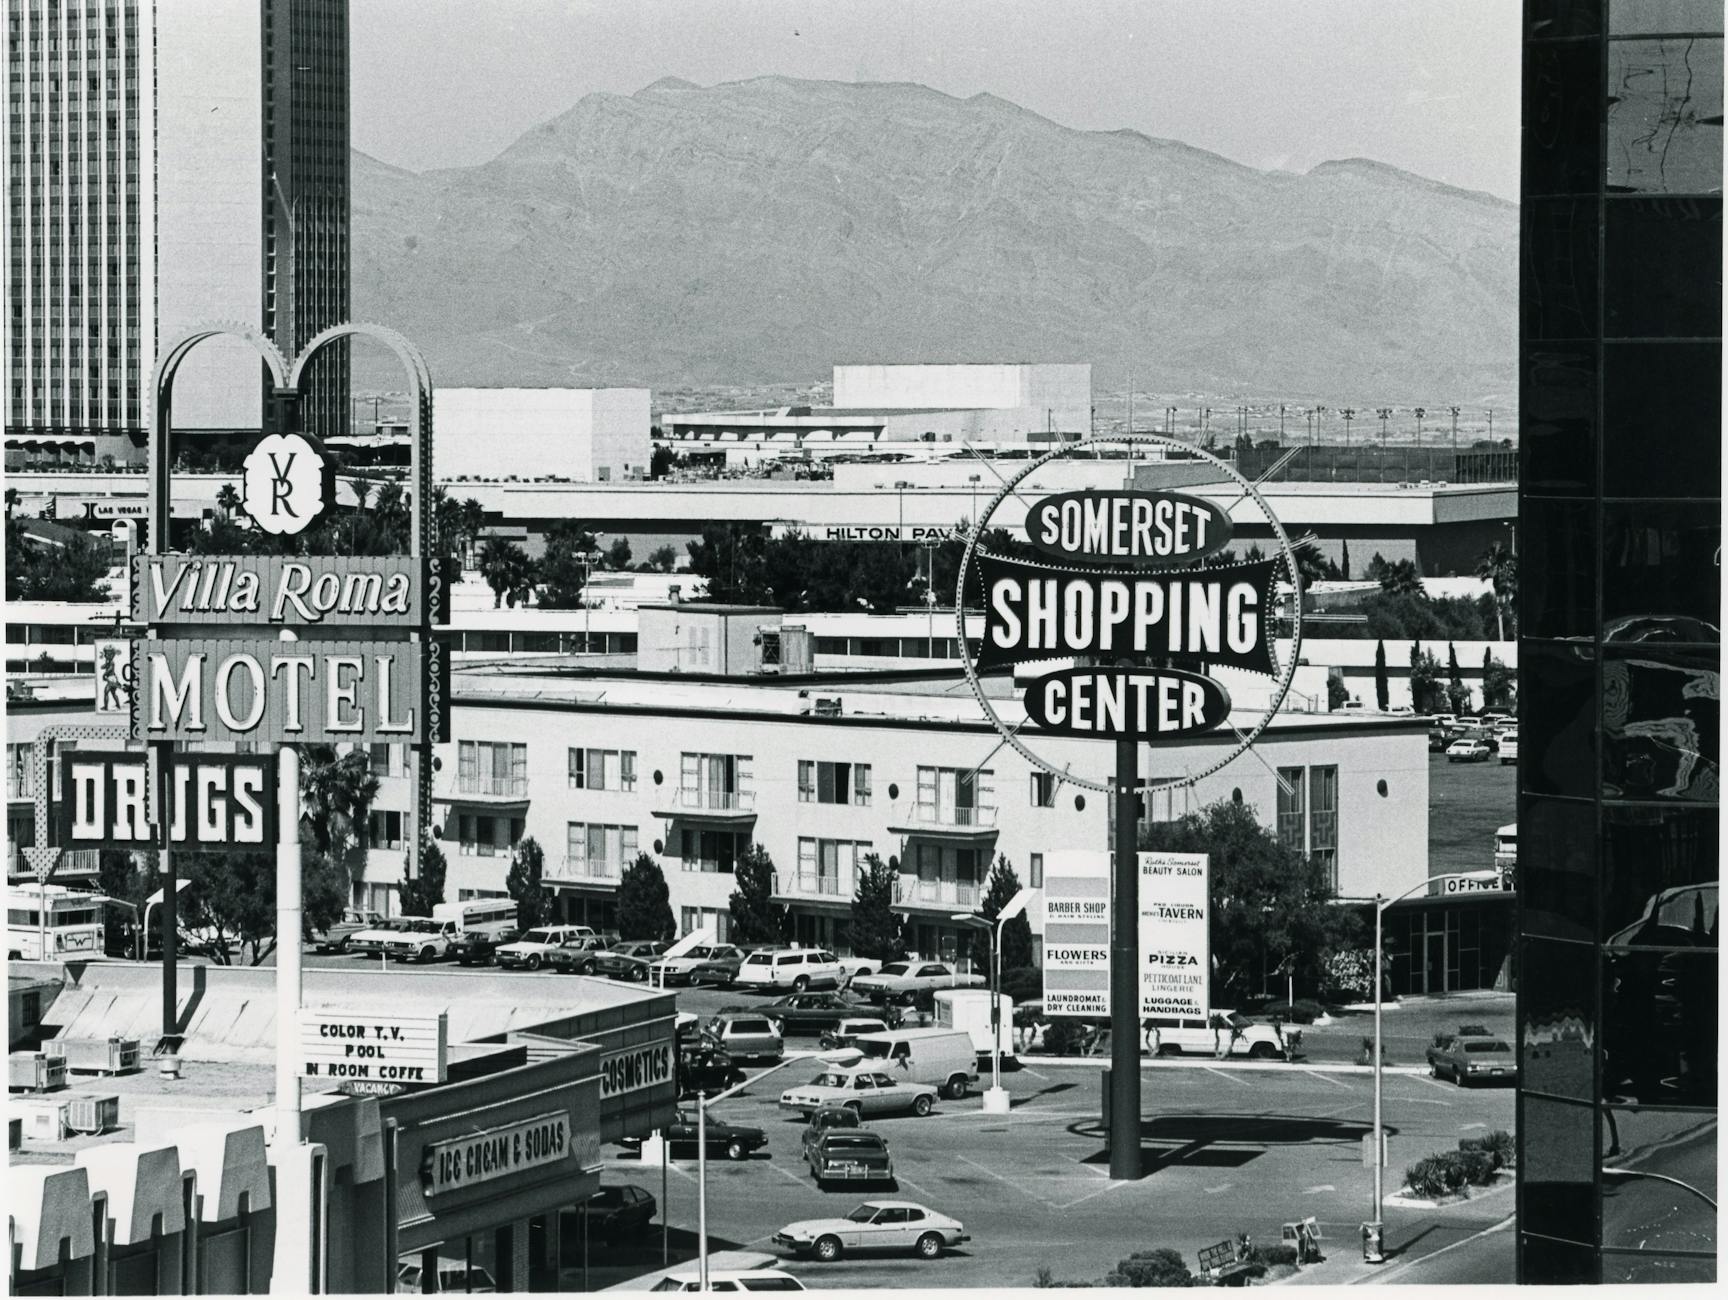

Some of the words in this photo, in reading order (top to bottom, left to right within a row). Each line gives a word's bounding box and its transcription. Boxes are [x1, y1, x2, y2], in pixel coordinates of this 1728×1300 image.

[98, 506, 113, 514] LAS
[117, 506, 142, 514] VEGAS
[1041, 497, 1211, 556] SOMERSET
[827, 527, 900, 539] HILTON
[912, 527, 954, 539] PAV
[149, 560, 260, 619] Villa
[269, 561, 411, 623] Roma
[991, 578, 1258, 655] SHOPPING
[147, 651, 414, 734] MOTEL
[1044, 674, 1206, 732] CENTER
[1143, 866, 1173, 875] BEAUTY
[1176, 868, 1203, 876] SALON
[1048, 902, 1081, 913] BARBER
[1083, 902, 1106, 913] SHOP
[1159, 907, 1204, 920] TAVERN
[1047, 949, 1107, 960] FLOWERS
[1149, 954, 1198, 966] PIZZA
[1143, 973, 1183, 984] PETTICOAT
[1183, 975, 1203, 985] LANE
[1152, 984, 1194, 993] LINGERIE
[1047, 994, 1101, 1003] LAUNDROMAT
[1144, 997, 1193, 1005] LUGGAGE
[1047, 1003, 1063, 1011] DRY
[1066, 1004, 1107, 1013] CLEANING
[1143, 1006, 1201, 1015] HANDBAGS
[320, 1023, 365, 1039] COLOR
[374, 1026, 405, 1042] T.V.
[345, 1044, 385, 1059] POOL
[328, 1063, 369, 1077] ROOM
[602, 1046, 668, 1096] COSMETICS
[353, 1082, 395, 1096] VACANCY
[440, 1149, 461, 1185] ICE
[466, 1135, 508, 1177] CREAM
[513, 1133, 521, 1164] &
[526, 1120, 564, 1161] SODAS
